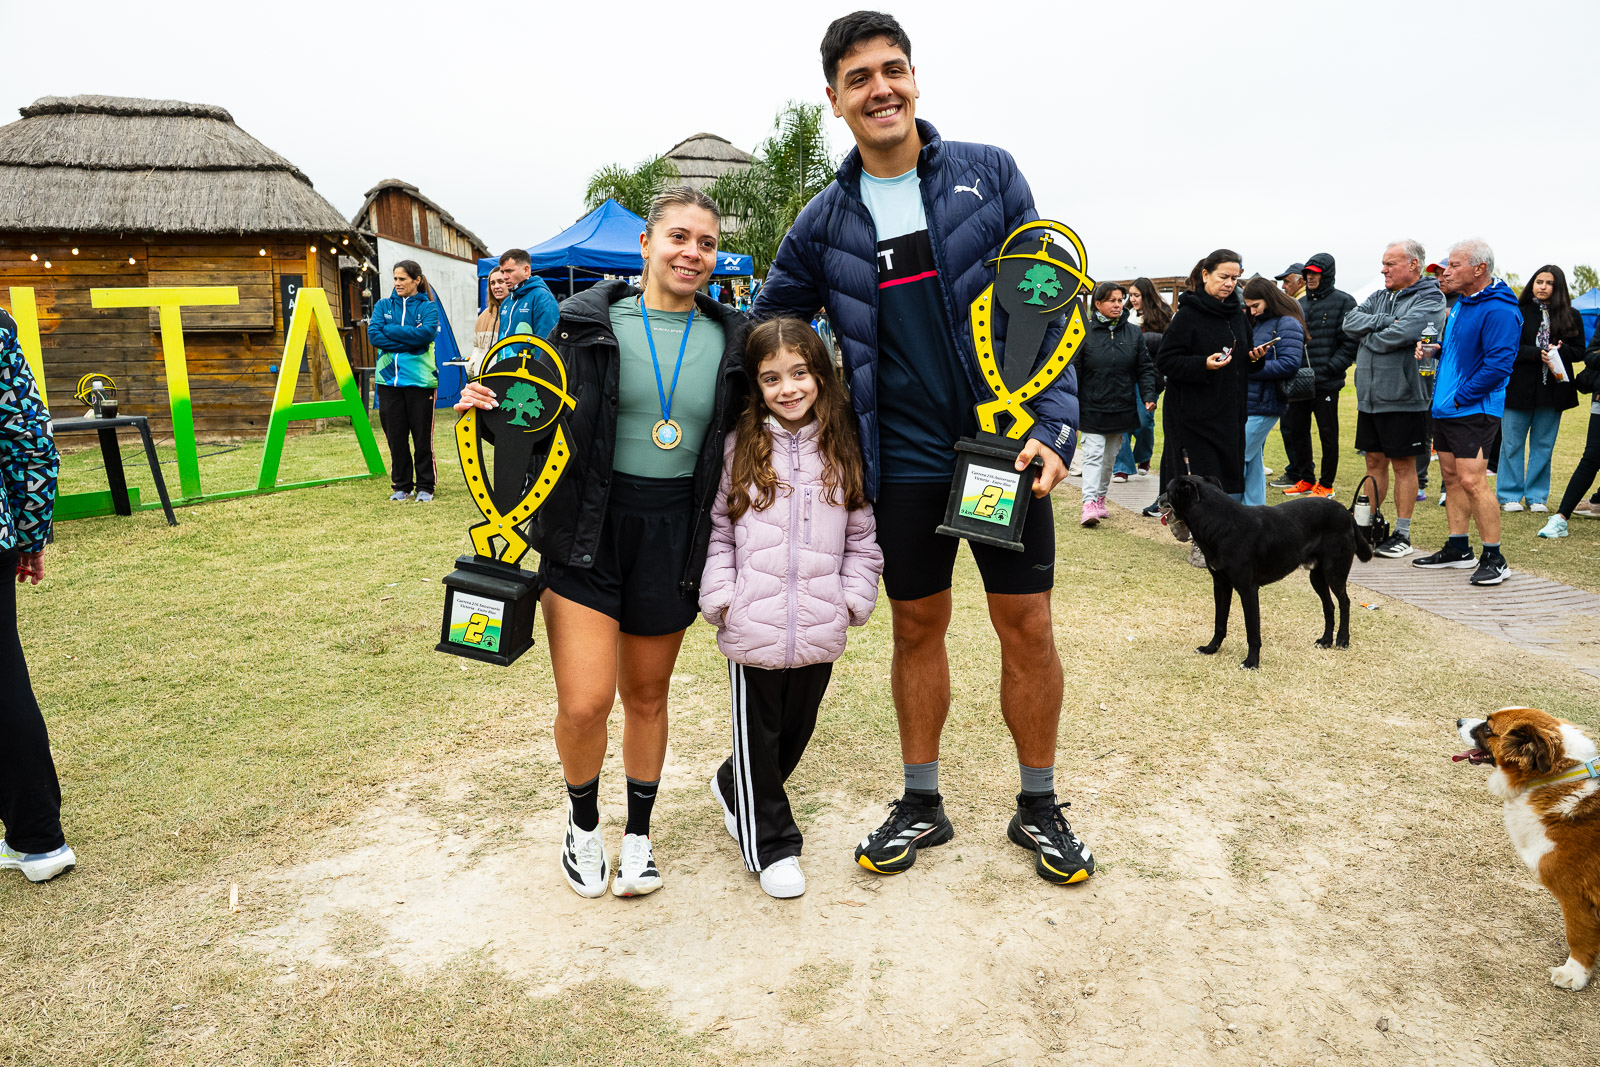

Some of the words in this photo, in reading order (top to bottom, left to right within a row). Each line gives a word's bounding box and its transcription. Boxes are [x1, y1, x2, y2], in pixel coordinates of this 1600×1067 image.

[974, 475, 990, 483] Victoria
[994, 475, 1016, 483] Aniversario
[973, 485, 1003, 518] 2
[479, 603, 500, 611] Aniversario
[463, 613, 489, 645] 2
